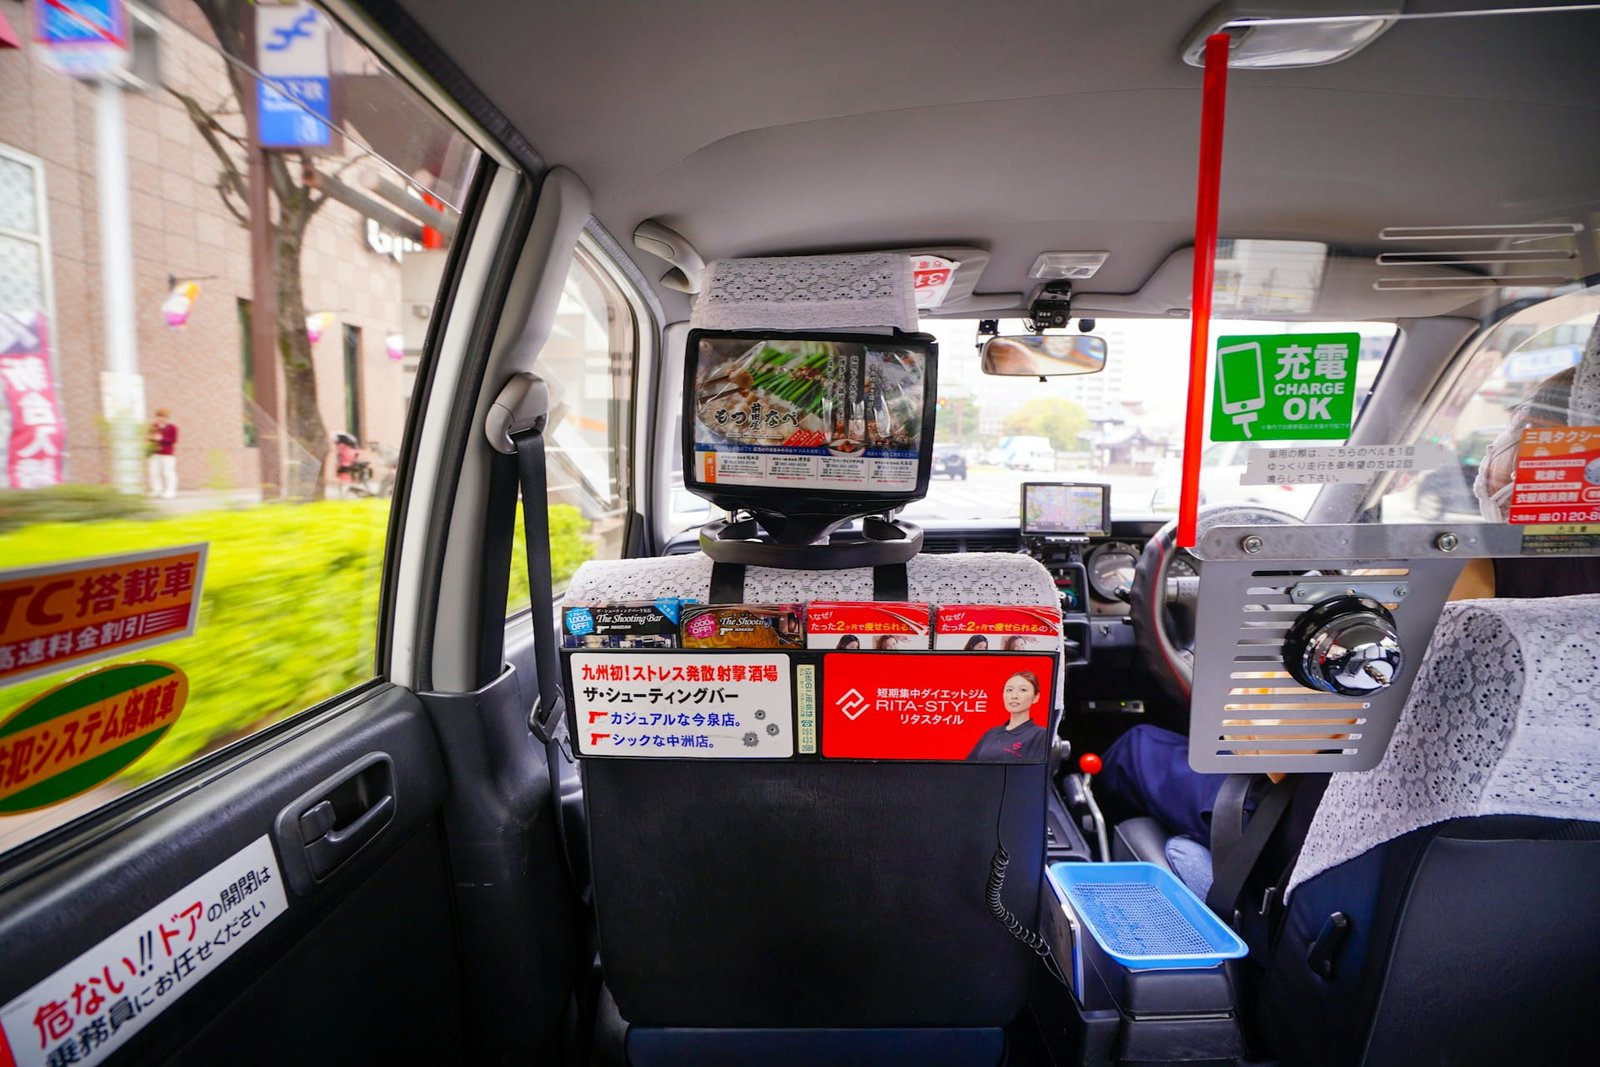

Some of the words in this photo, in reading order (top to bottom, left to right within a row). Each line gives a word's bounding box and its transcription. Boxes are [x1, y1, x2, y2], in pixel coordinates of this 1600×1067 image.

[1274, 344, 1349, 380] 充電
[1274, 382, 1345, 396] CHARGE
[1283, 397, 1333, 421] OK
[596, 614, 612, 623] The
[612, 613, 645, 625] Shooting
[647, 613, 664, 622] Bar
[720, 617, 736, 626] The
[583, 687, 739, 704] ザ・シューティングバー
[876, 687, 988, 699] 短期集中ダイエットジム
[875, 700, 987, 712] RITA-STYLE
[611, 711, 741, 727] カジュアルな今泉店。
[900, 714, 965, 725] リタスタイル
[612, 733, 715, 749] シックな中洲店。
[45, 900, 267, 1067] 乗務員にお任せください
